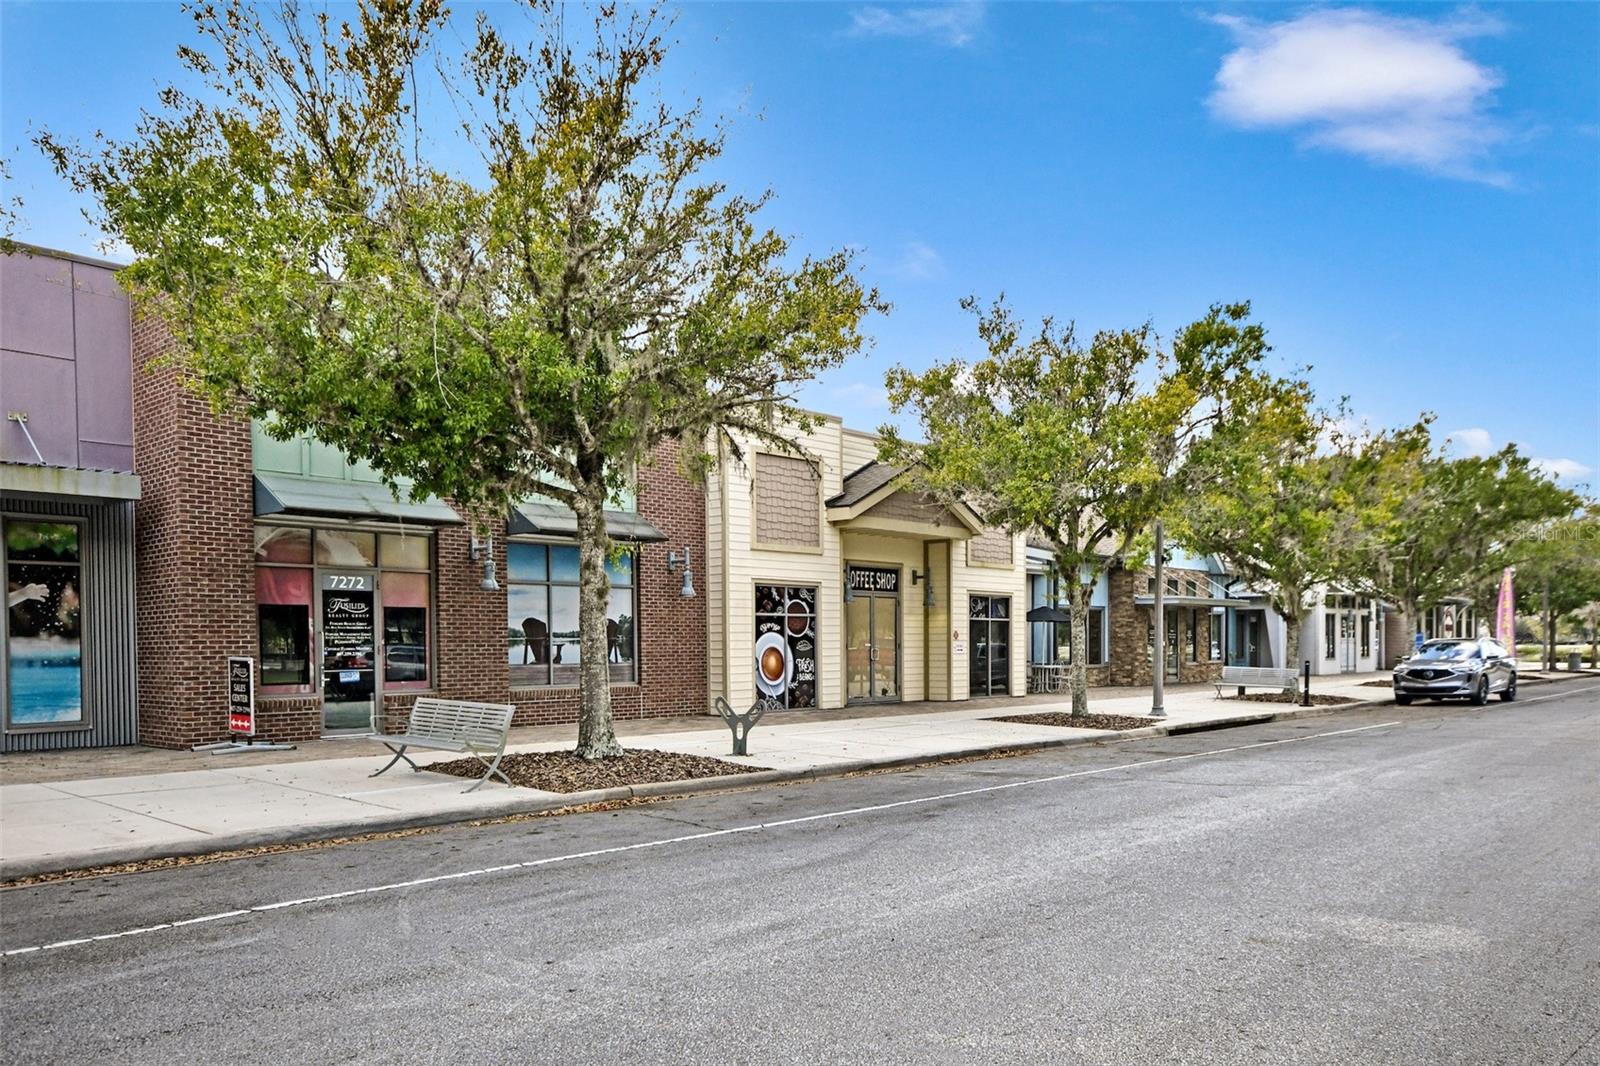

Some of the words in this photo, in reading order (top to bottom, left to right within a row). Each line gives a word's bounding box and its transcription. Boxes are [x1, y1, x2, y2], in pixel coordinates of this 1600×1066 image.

[330, 575, 365, 589] 7272
[850, 570, 875, 588] OFFEE
[876, 572, 896, 590] SHOP
[233, 683, 246, 692] SALES
